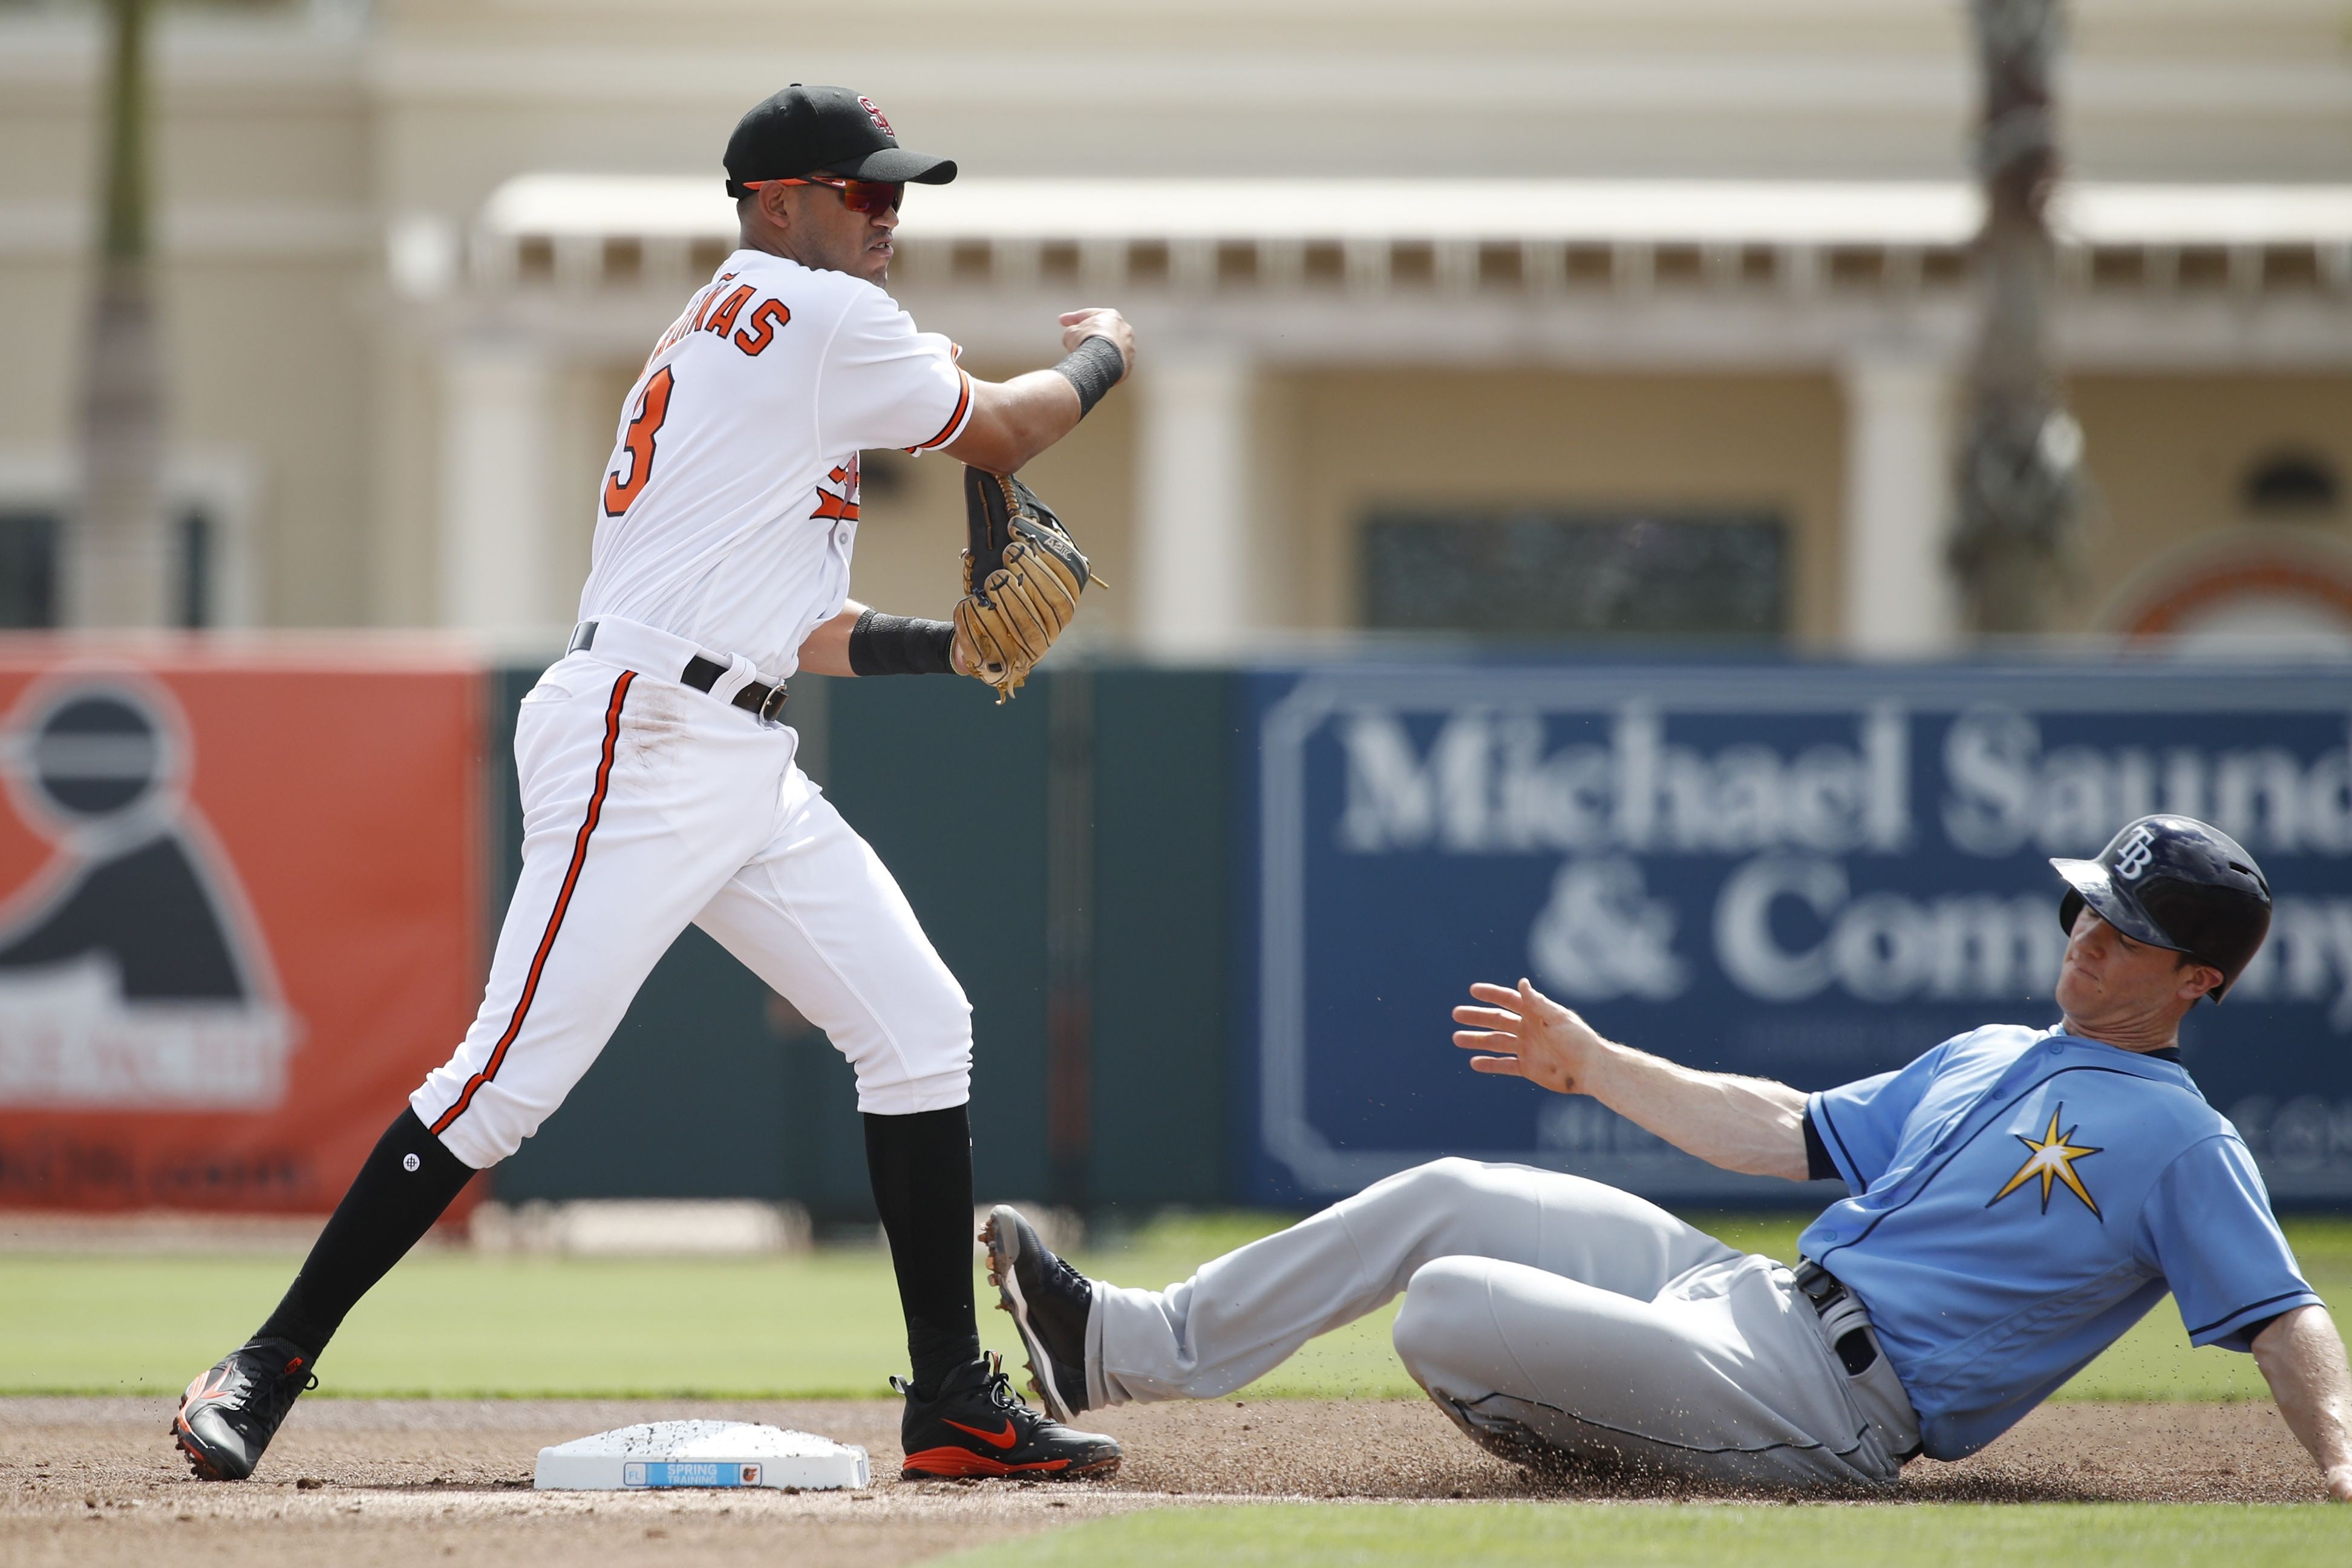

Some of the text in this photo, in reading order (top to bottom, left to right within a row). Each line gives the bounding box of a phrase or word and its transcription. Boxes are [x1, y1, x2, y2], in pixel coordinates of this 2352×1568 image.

[604, 364, 675, 517] 3
[1044, 537, 1071, 561] A2K
[1339, 697, 1914, 852] Michael
[2115, 825, 2155, 880] TB
[1527, 856, 2352, 1034] & Comny
[629, 1471, 640, 1480] FL
[667, 1464, 717, 1475] SPRING
[668, 1476, 716, 1485] TRAINING
